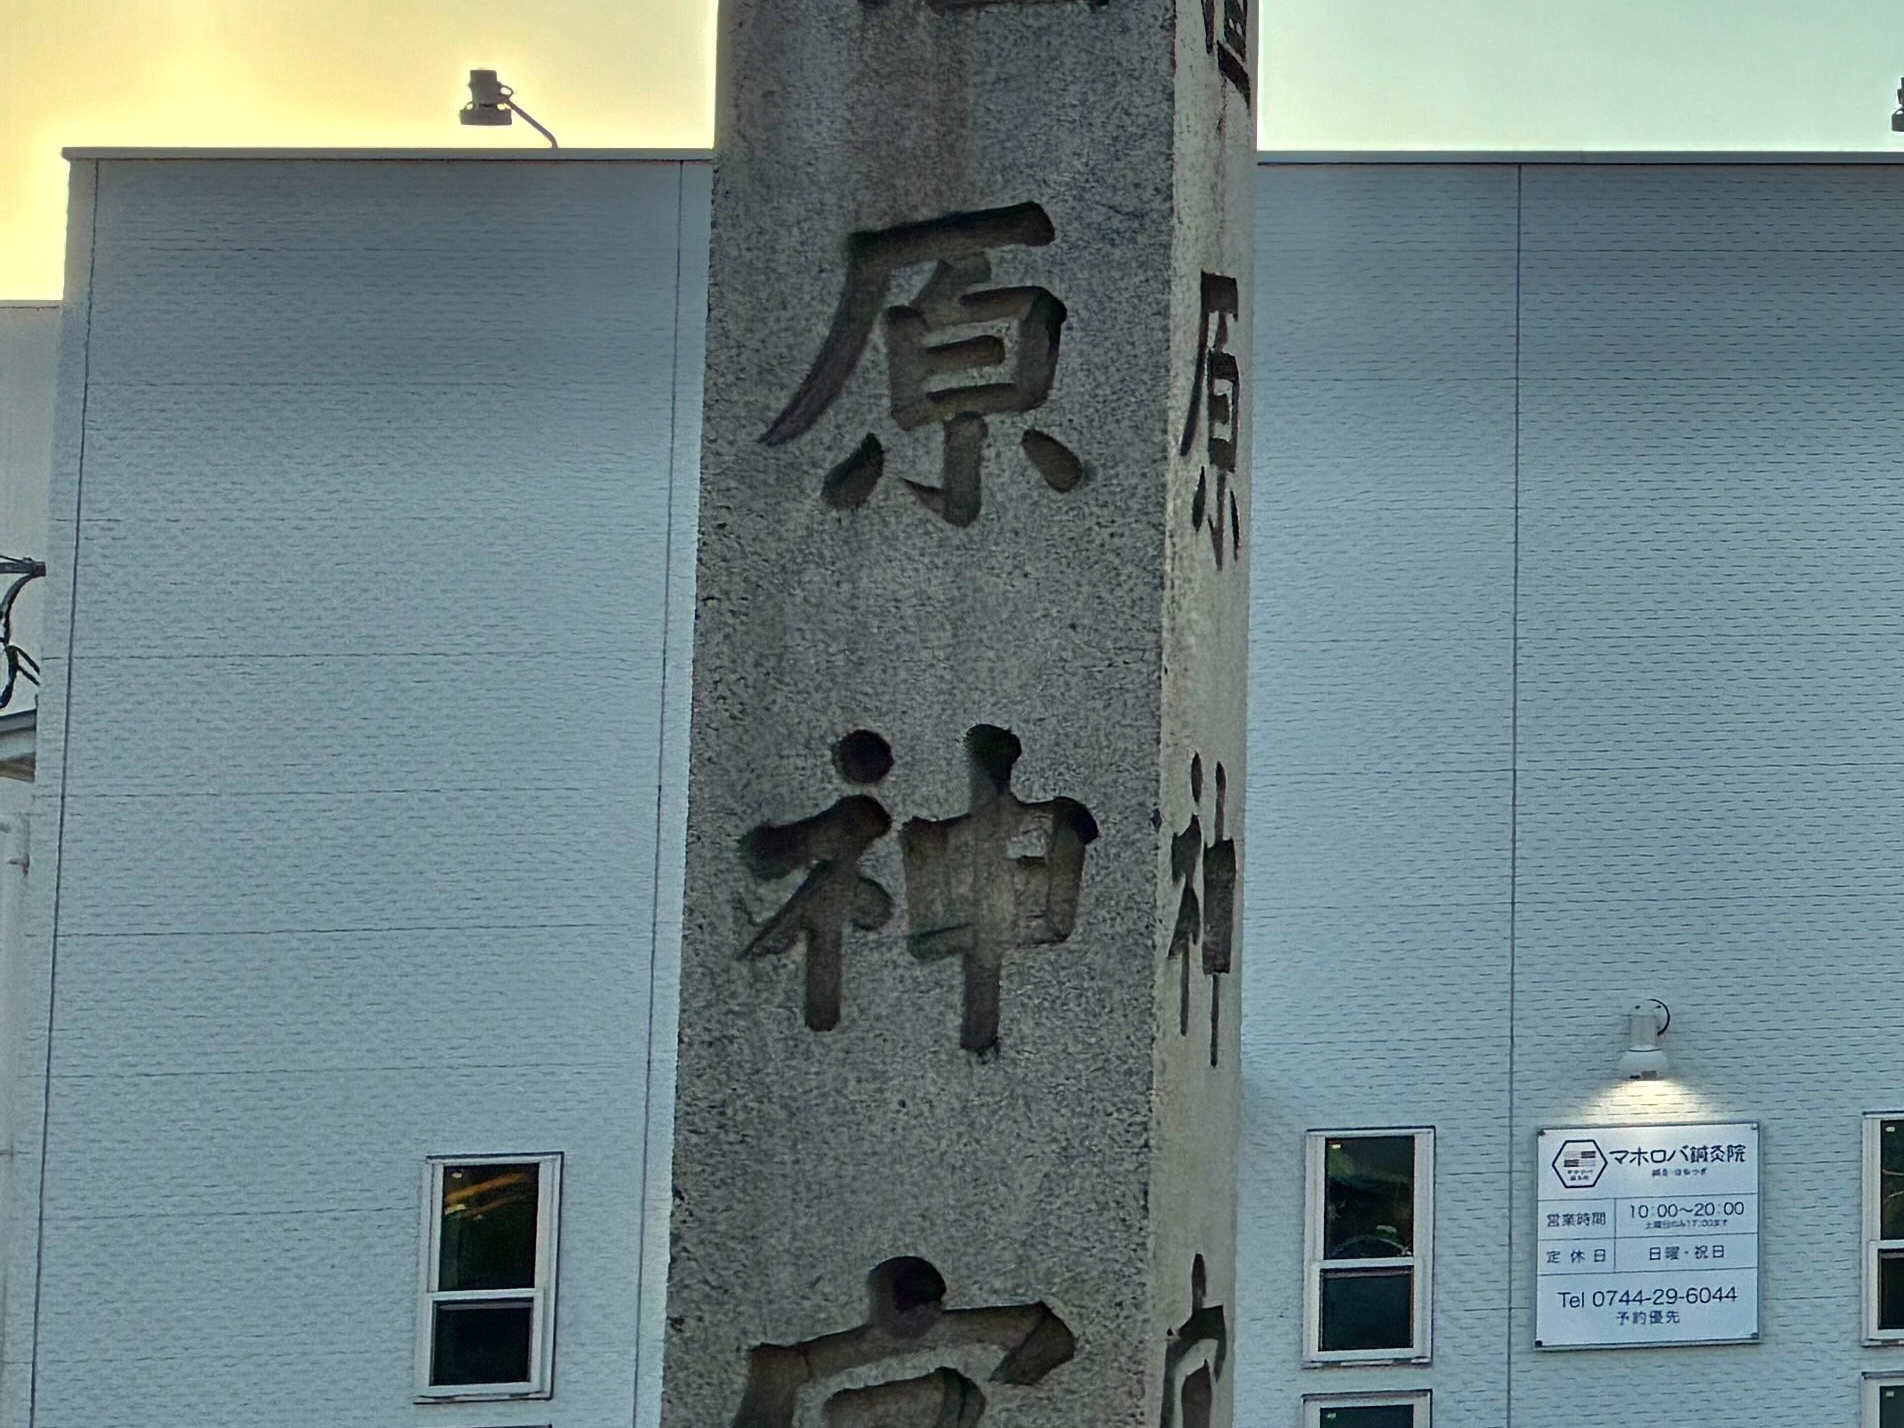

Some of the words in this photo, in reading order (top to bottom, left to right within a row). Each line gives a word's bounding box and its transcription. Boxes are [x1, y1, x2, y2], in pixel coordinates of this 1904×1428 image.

[1608, 1144, 1747, 1167] マホロバ鍼灸院
[1546, 1212, 1607, 1228] 営業時間
[1557, 1291, 1585, 1309] Tel
[1592, 1286, 1738, 1308] 0744-29-6044
[1616, 1310, 1681, 1326] 予約優先
